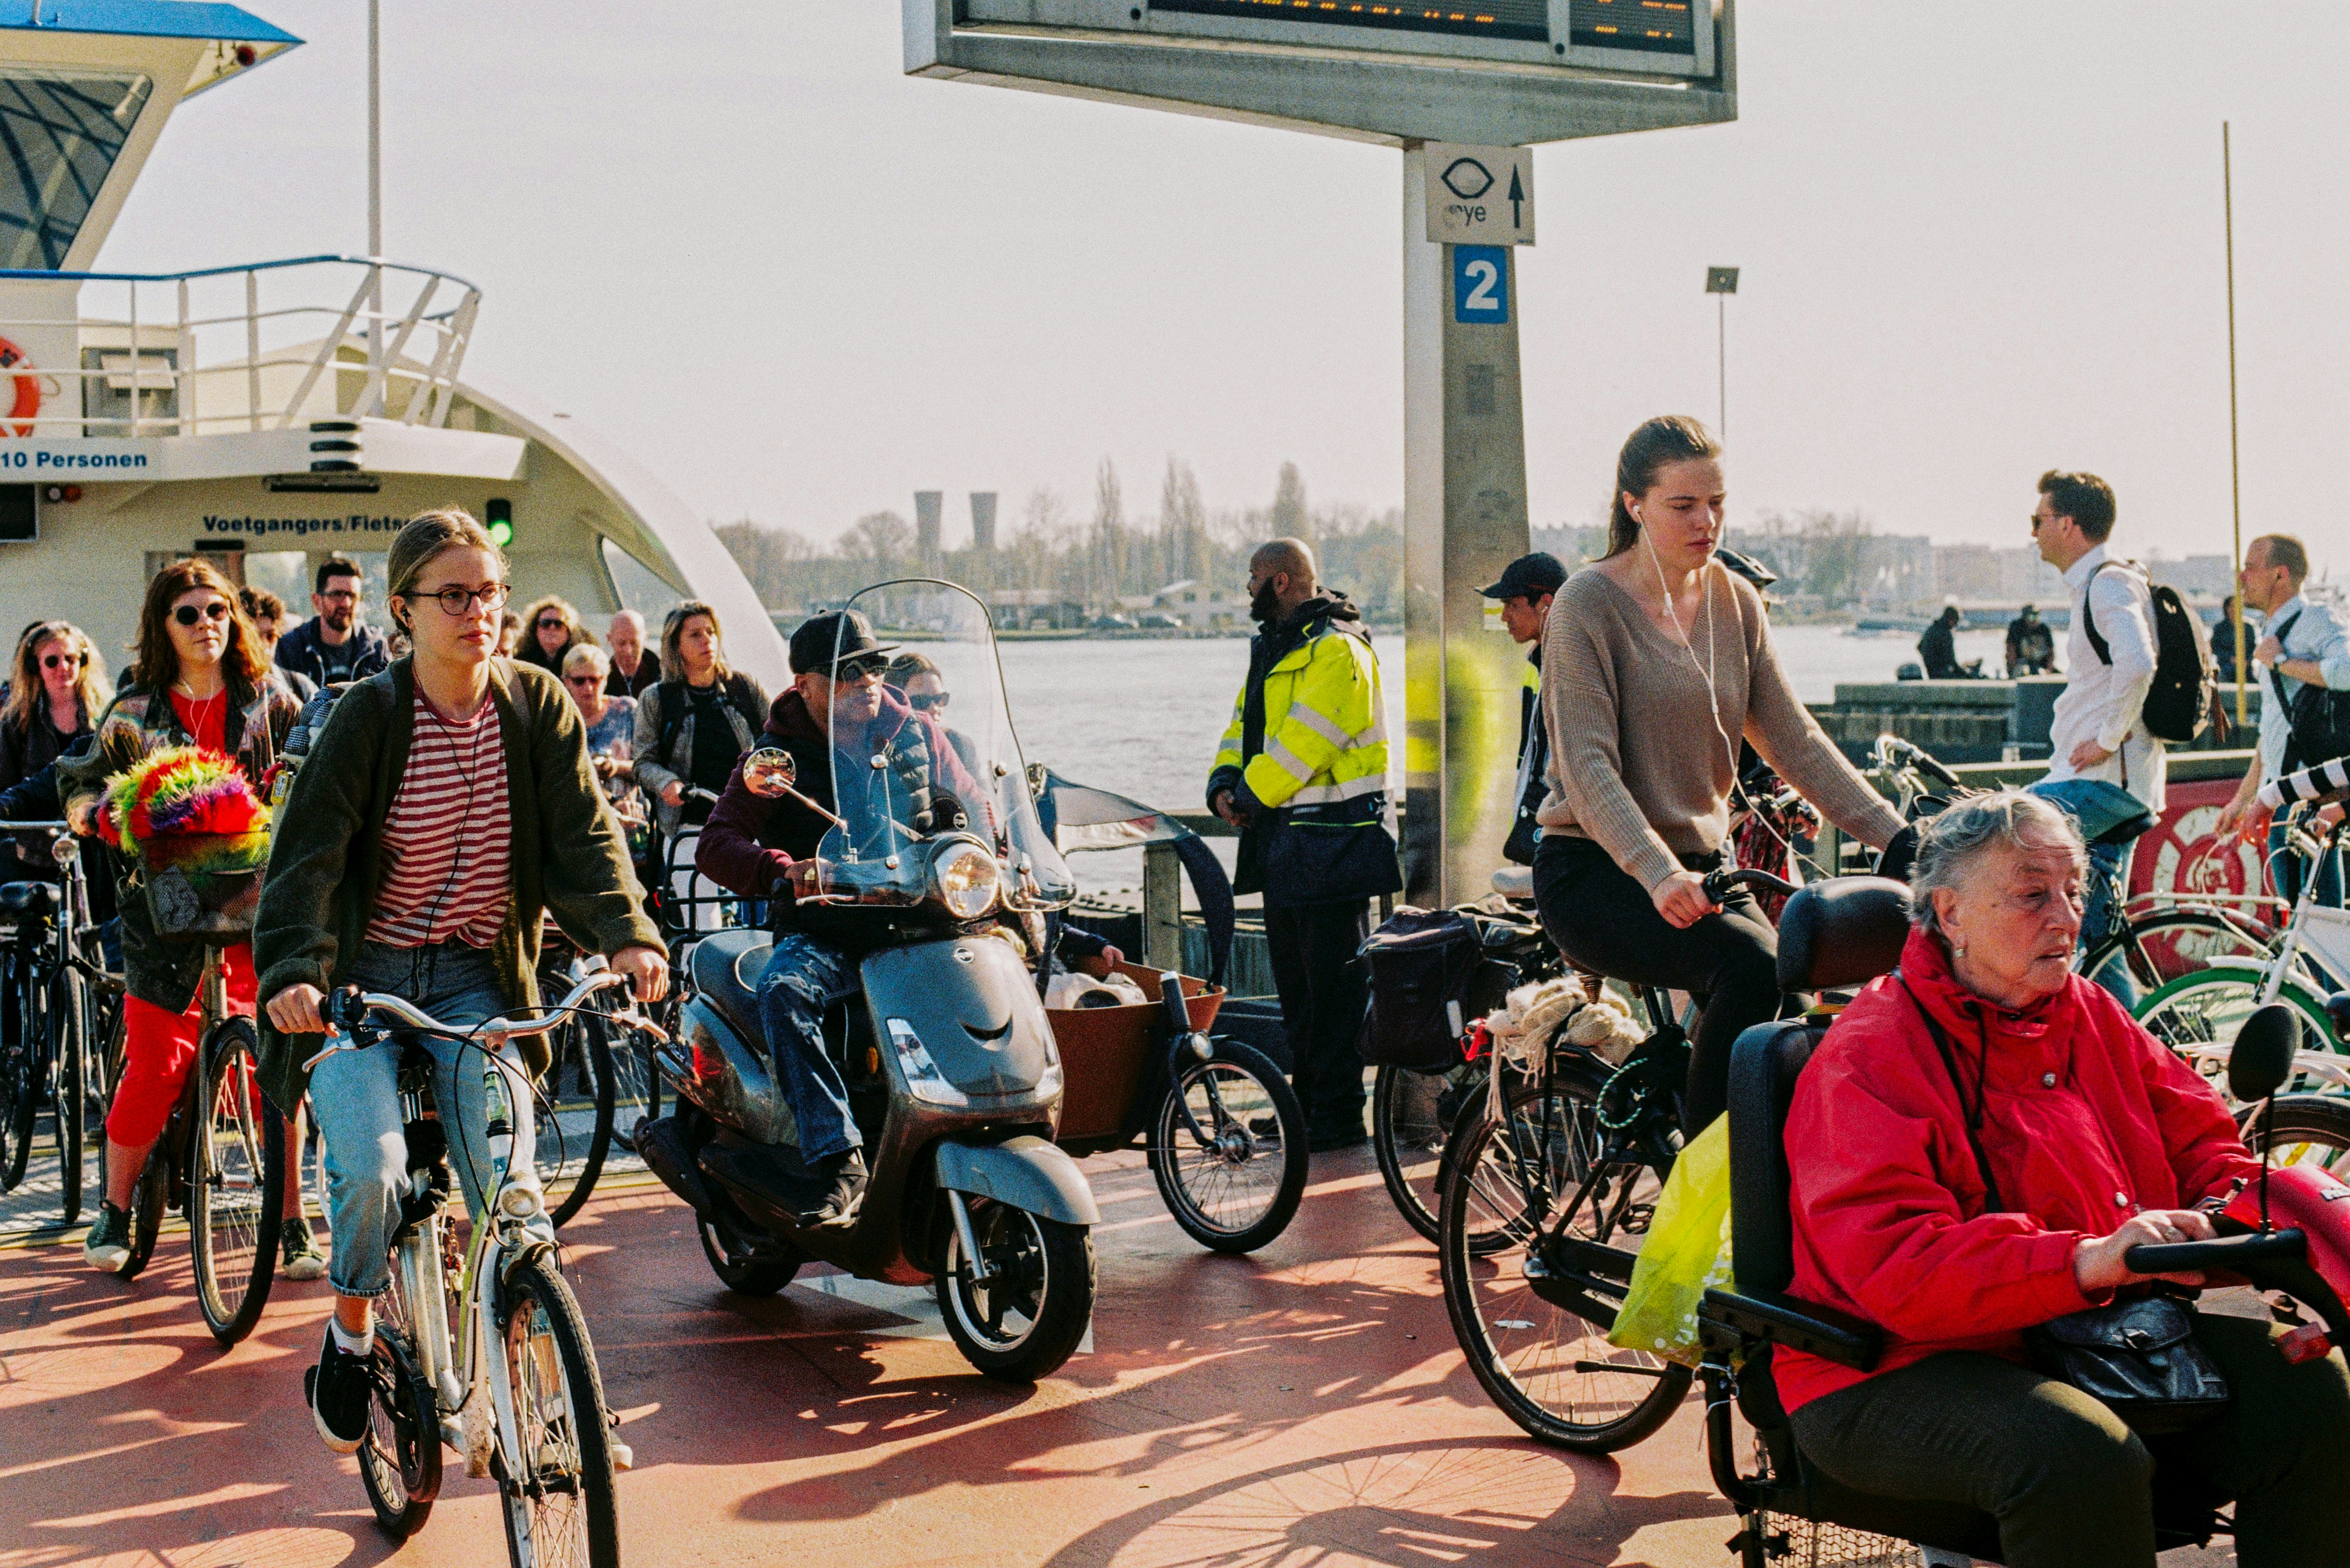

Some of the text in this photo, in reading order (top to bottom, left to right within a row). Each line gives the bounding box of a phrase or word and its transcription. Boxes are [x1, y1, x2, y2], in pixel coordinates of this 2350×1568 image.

[1449, 205, 1486, 227] ye
[1465, 260, 1498, 310] 2
[37, 451, 147, 468] Personen
